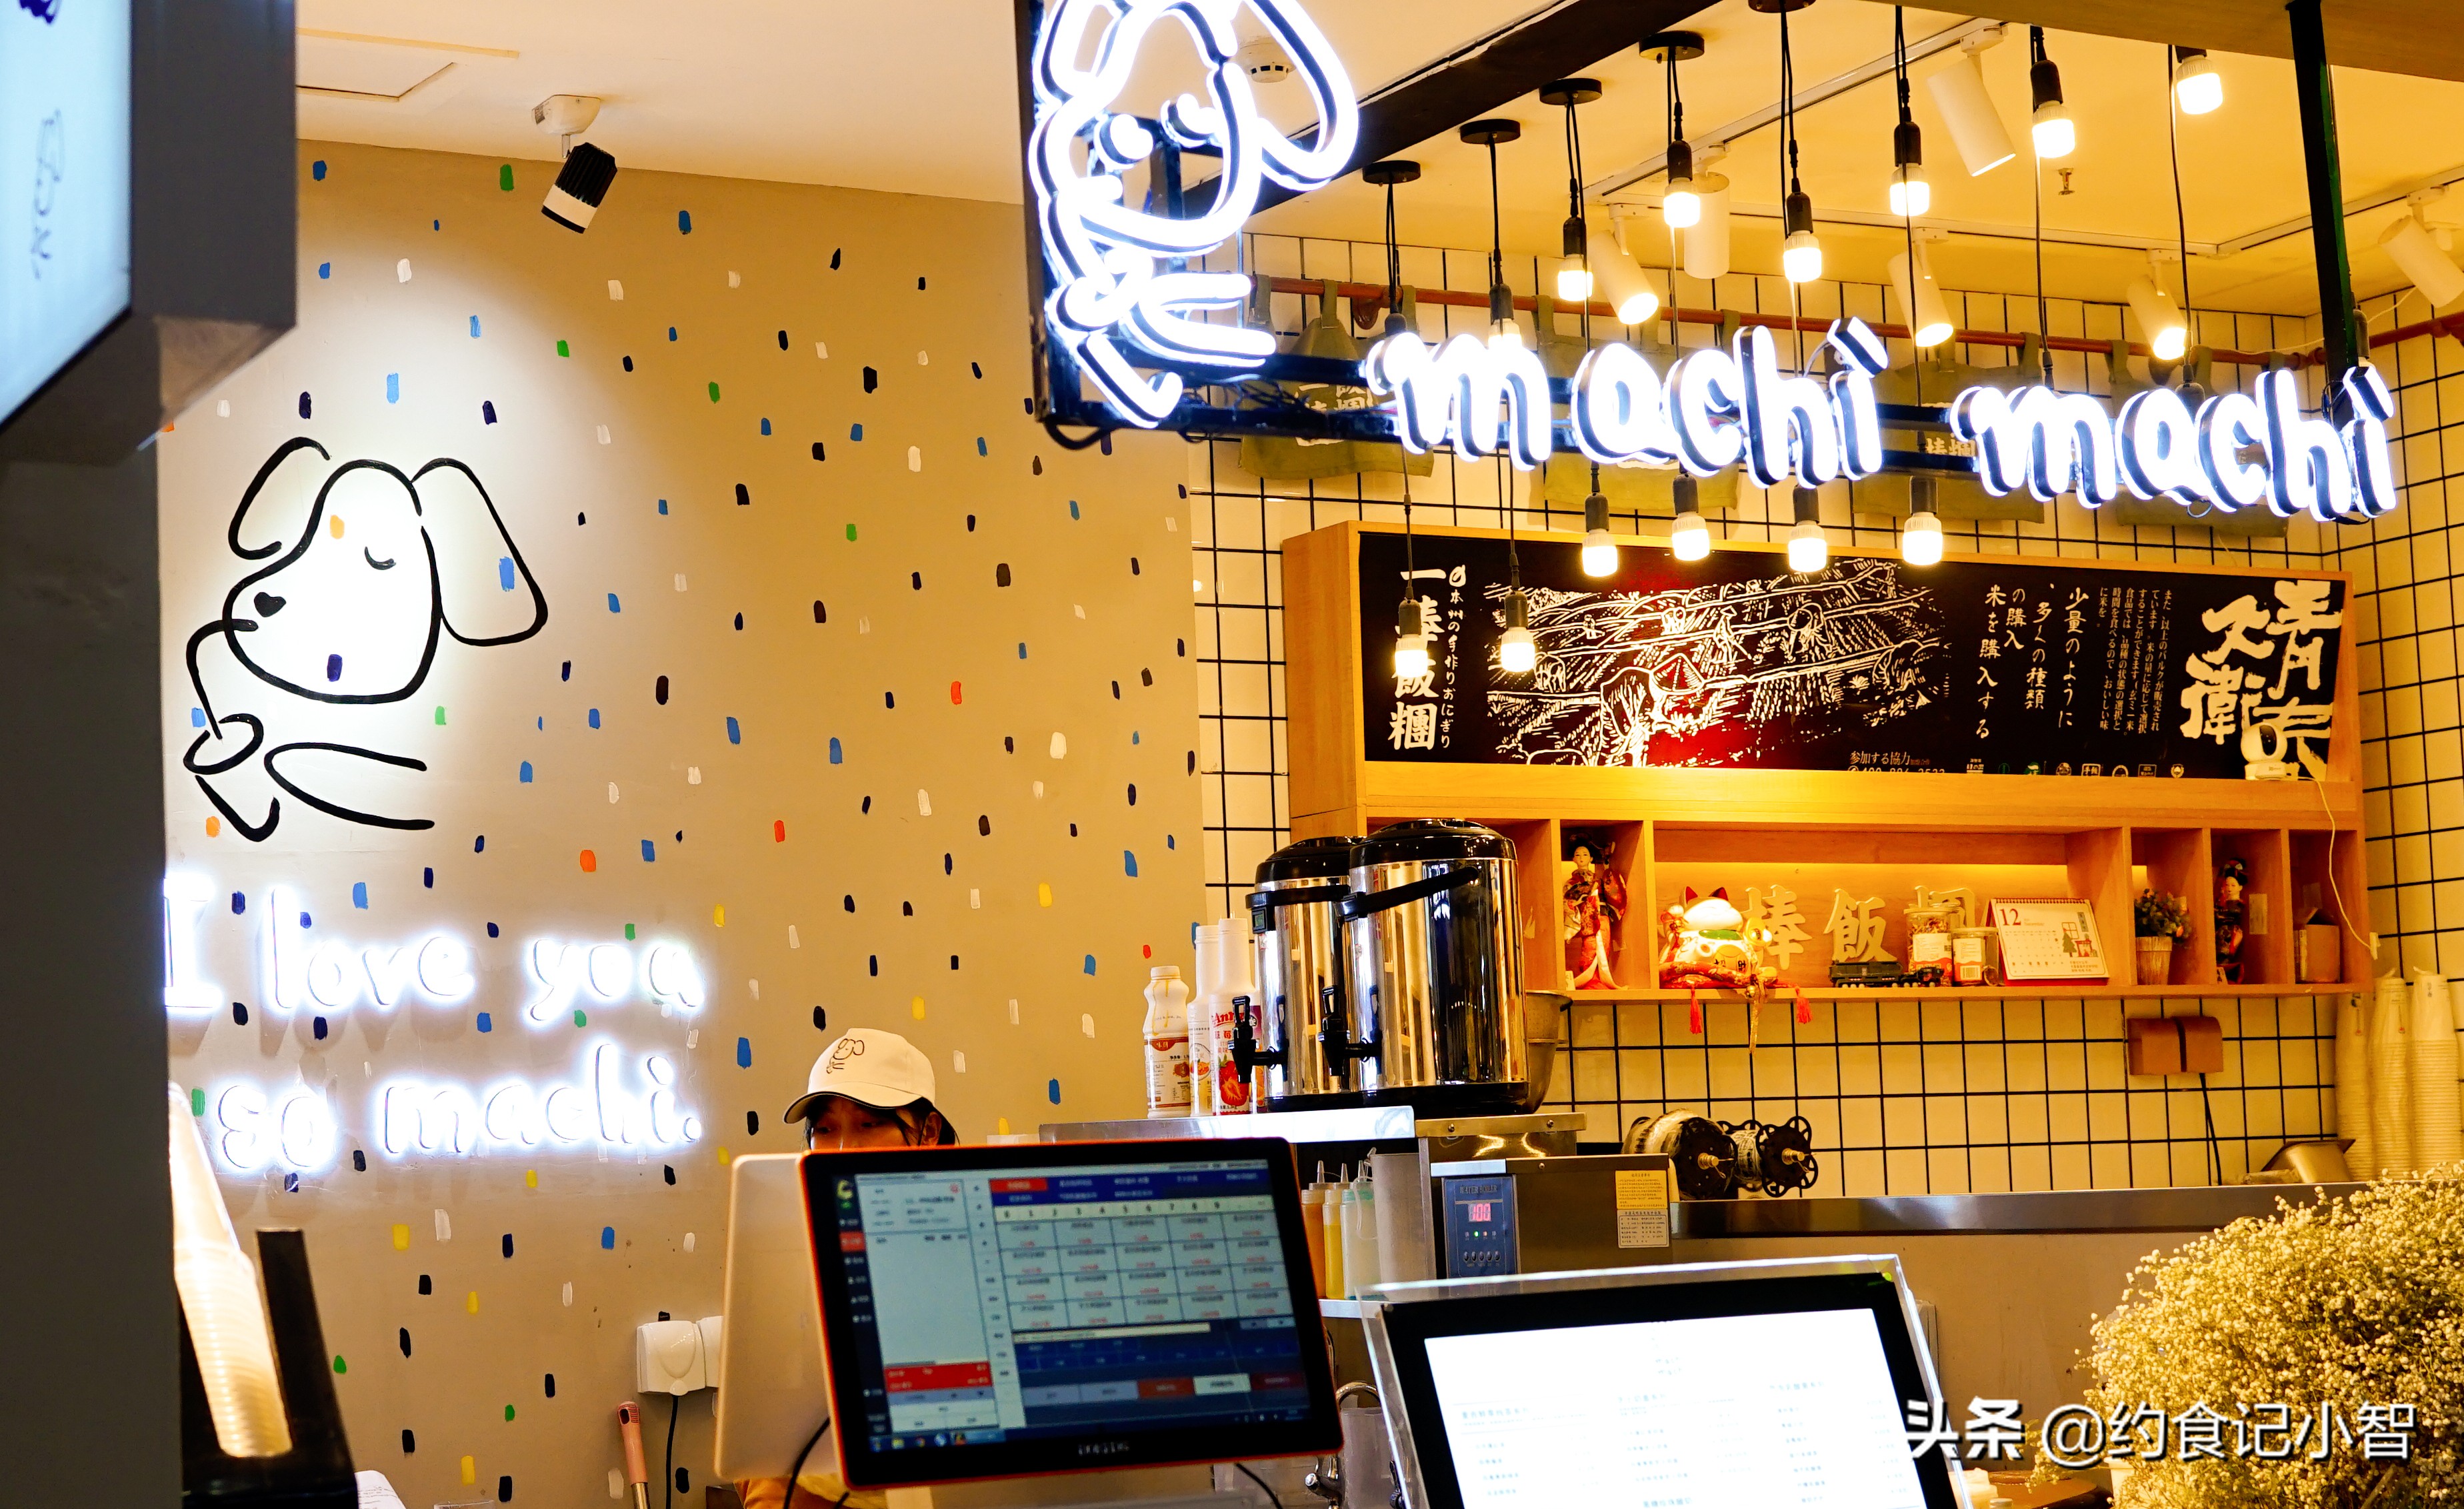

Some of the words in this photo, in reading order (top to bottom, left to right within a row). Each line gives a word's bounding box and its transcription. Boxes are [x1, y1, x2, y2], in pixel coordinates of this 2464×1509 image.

[1361, 315, 1889, 489] machi
[1950, 362, 2397, 521] machi
[1976, 584, 2007, 739] 米を購入する
[2004, 588, 2027, 650] の購入
[2059, 587, 2089, 728] 少量のように
[268, 886, 477, 1010] love
[1999, 908, 2022, 926] 12
[215, 1082, 335, 1170] so
[382, 1042, 705, 1157] machi.
[1460, 1185, 1479, 1194] WATER
[1472, 1203, 1491, 1222] 100
